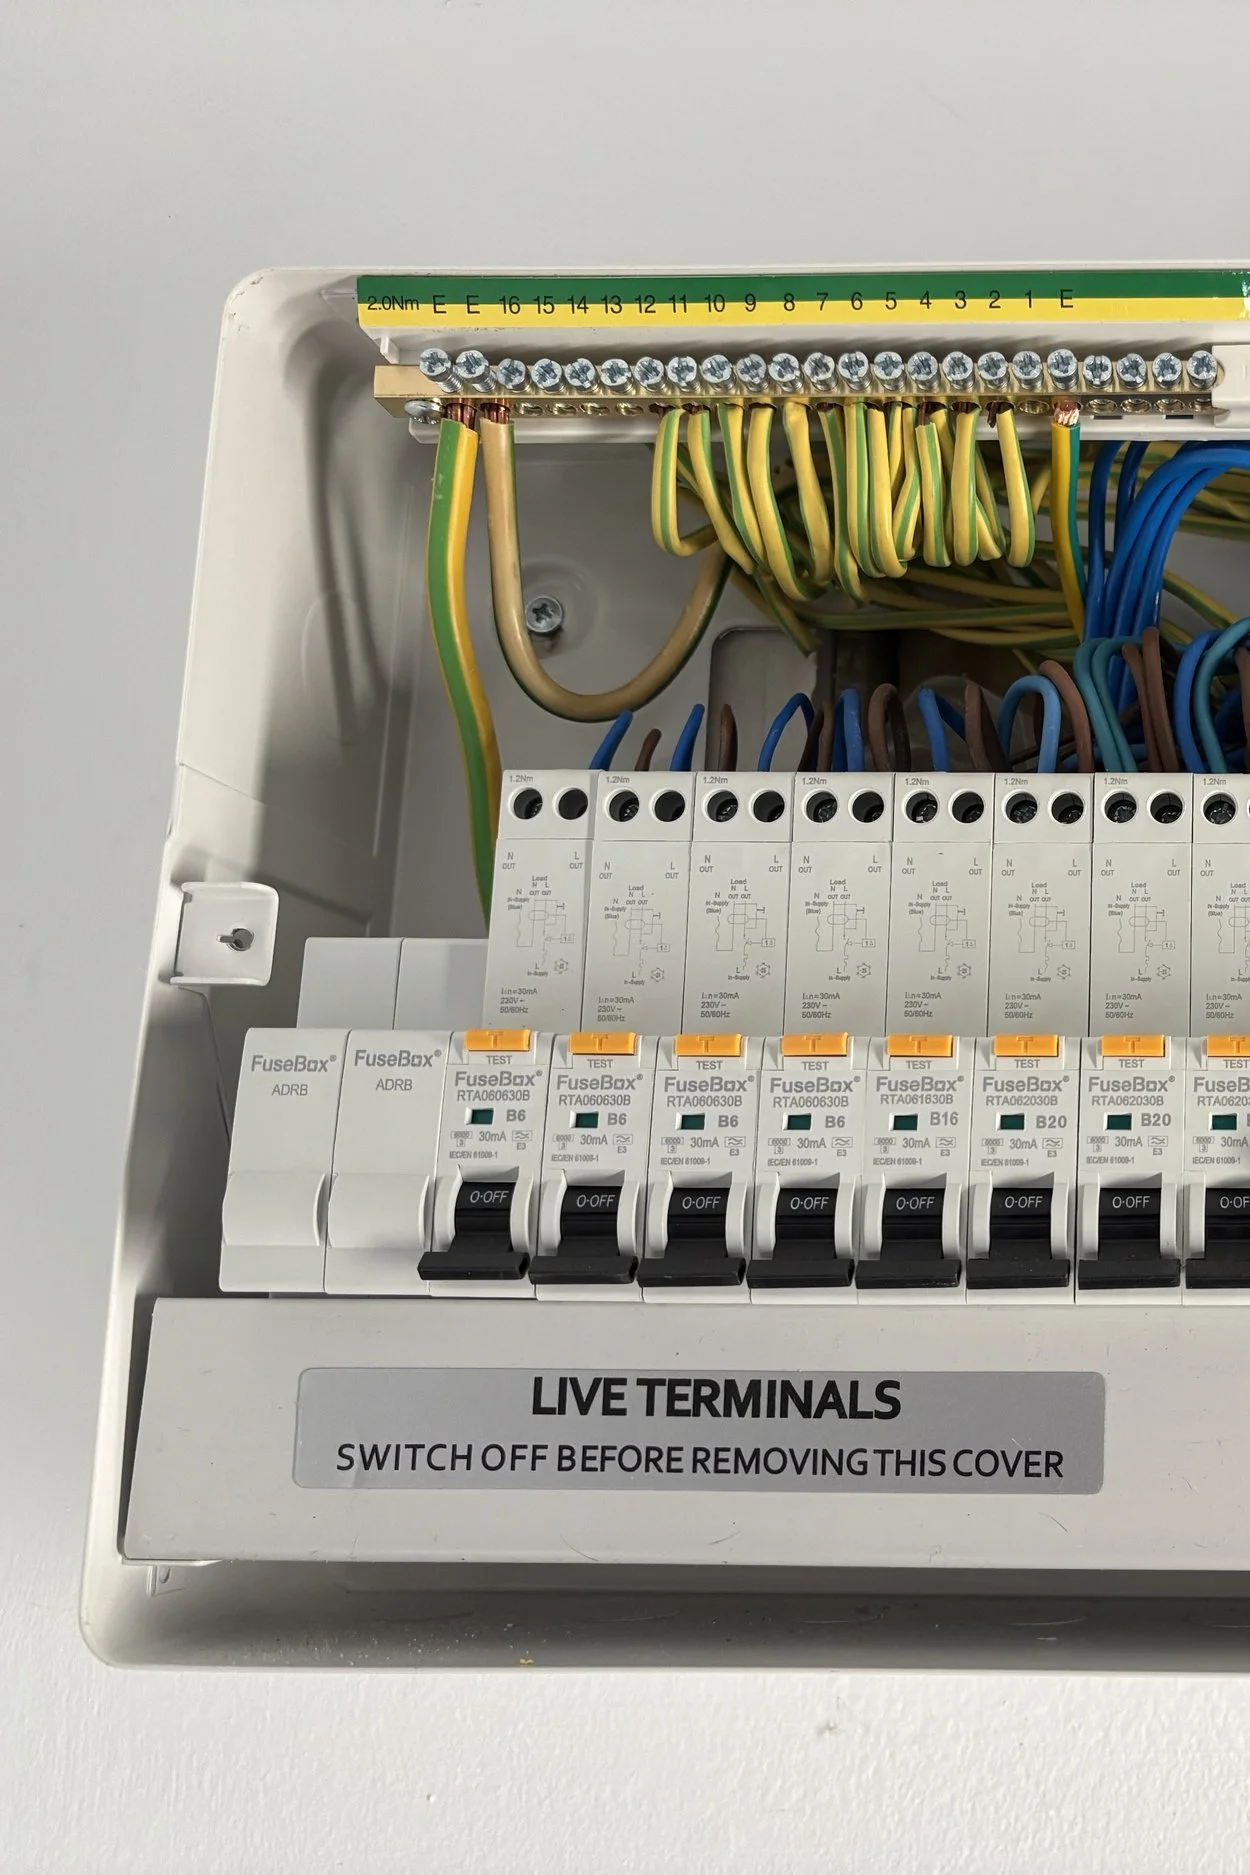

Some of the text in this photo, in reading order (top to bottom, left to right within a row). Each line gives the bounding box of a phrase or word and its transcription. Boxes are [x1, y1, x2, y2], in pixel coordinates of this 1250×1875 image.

[367, 290, 1073, 314] 2.0Nm E E 16 15 14 13 12 11 10 9 8 7 6 5 4 3 2 1 E
[486, 1055, 512, 1065] TEST
[696, 1061, 723, 1070] TEST
[906, 1060, 932, 1069] TEST
[1014, 1059, 1040, 1068] TEST
[272, 1084, 308, 1096] ADRB
[376, 1079, 412, 1091] ADRB
[457, 1090, 530, 1101] RTA060630B
[559, 1095, 630, 1106] RTA060630B
[667, 1095, 742, 1107] RTA060630B
[881, 1094, 953, 1104] RTA061630B
[986, 1095, 1057, 1106] RTA062030B
[1092, 1096, 1164, 1106] RTA062030B
[773, 1096, 848, 1108] RTA060630B
[506, 1109, 525, 1122] B6
[608, 1113, 627, 1125] B6
[718, 1115, 738, 1127] B6
[930, 1112, 958, 1126] B16
[1036, 1115, 1067, 1128] B20
[1141, 1113, 1171, 1126] B20
[825, 1116, 845, 1128] B6
[580, 1134, 608, 1145] 30mA
[903, 1137, 930, 1148] 30mA
[1221, 1136, 1249, 1148] 30mA
[532, 1377, 902, 1422] LIVE TERMINALS
[337, 1444, 1063, 1477] SWITCH OFF BEFORE REMOVING THIS COVER
